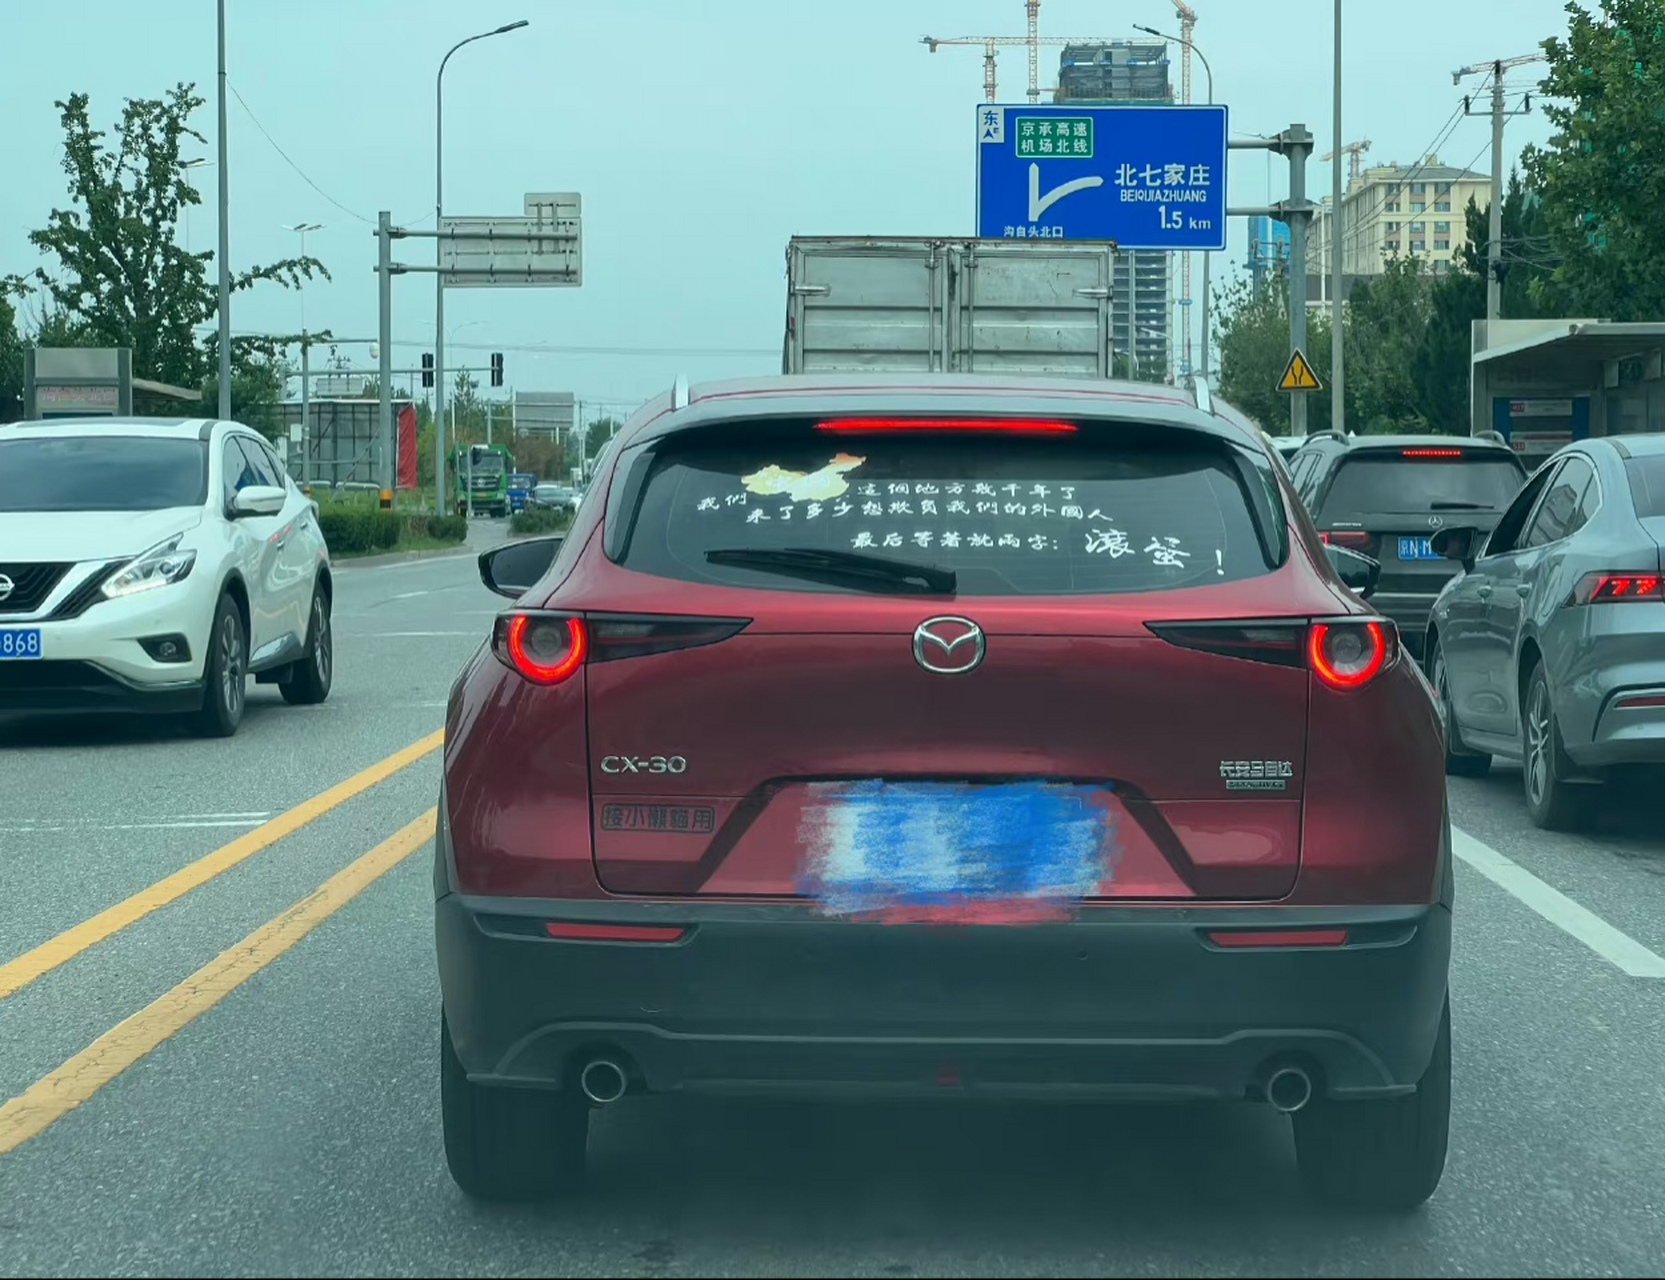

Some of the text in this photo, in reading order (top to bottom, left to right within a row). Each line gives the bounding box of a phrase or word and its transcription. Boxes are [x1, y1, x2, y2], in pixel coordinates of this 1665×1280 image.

[983, 110, 999, 126] 东
[1021, 121, 1087, 136] 京承高速
[1021, 138, 1087, 153] 机场北线
[1114, 162, 1210, 186] 北七家庄
[1158, 205, 1211, 229] 1.5 km
[0, 633, 38, 653] 868
[601, 755, 687, 773] CX-30
